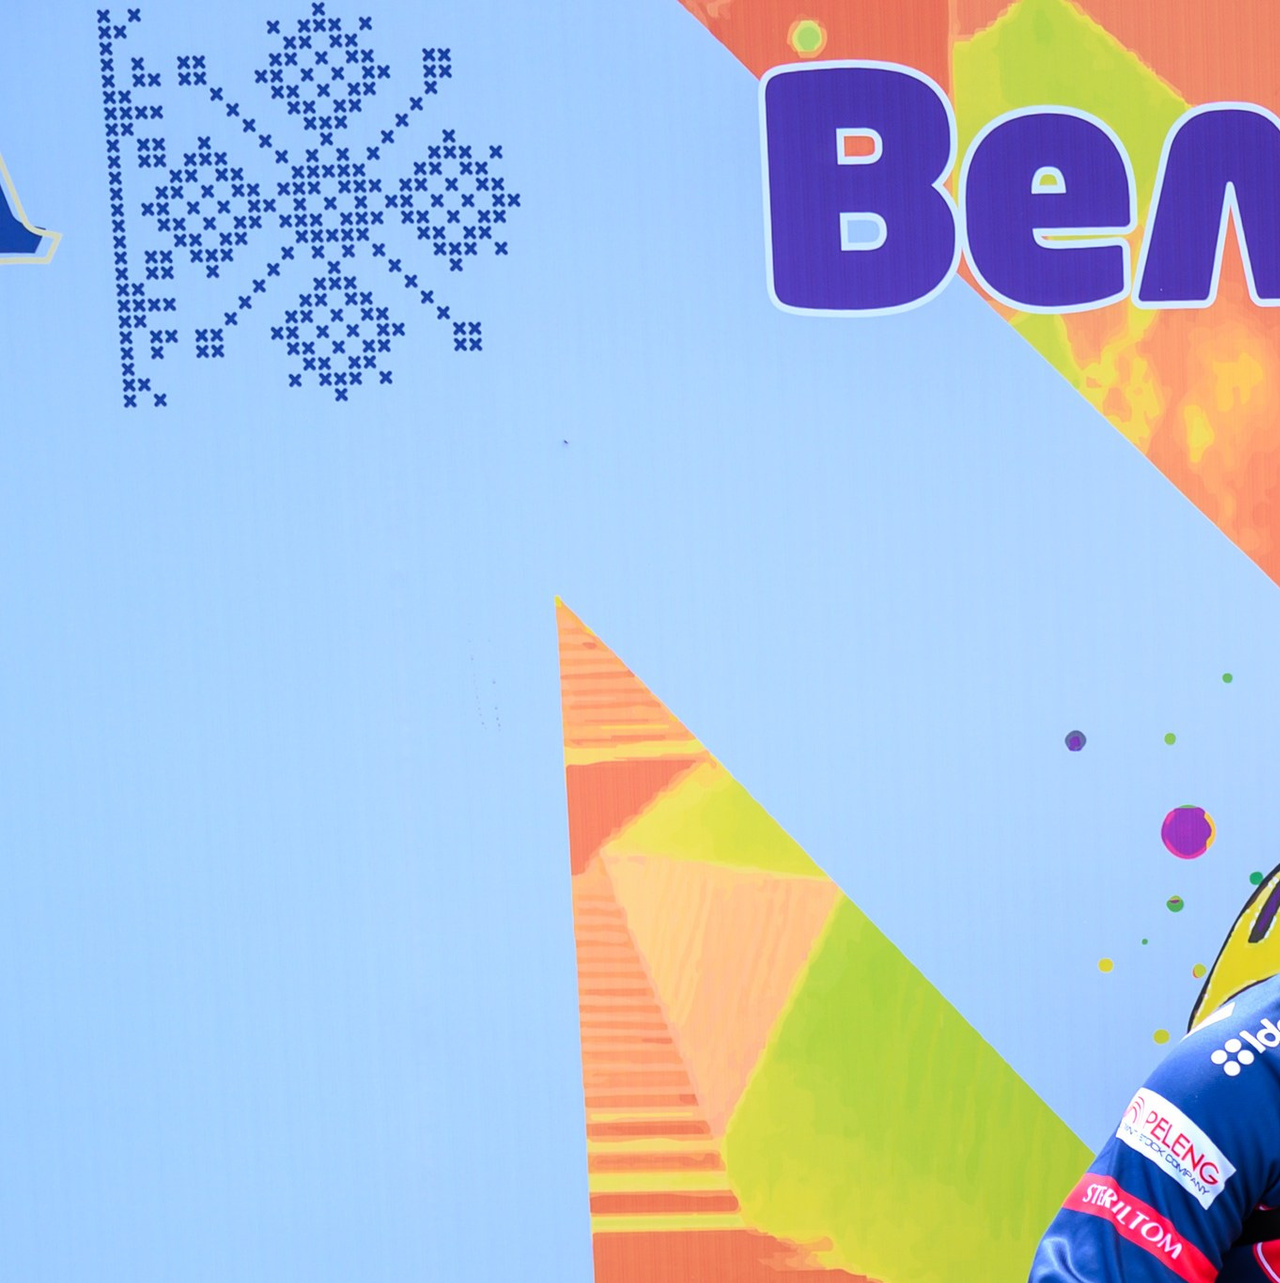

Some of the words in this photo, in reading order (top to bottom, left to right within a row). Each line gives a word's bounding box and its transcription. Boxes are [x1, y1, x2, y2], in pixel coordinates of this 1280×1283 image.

[1143, 1110, 1219, 1185] PELENG
[1165, 1153, 1210, 1195] COMPANY
[1082, 1183, 1183, 1260] STERILTOM
